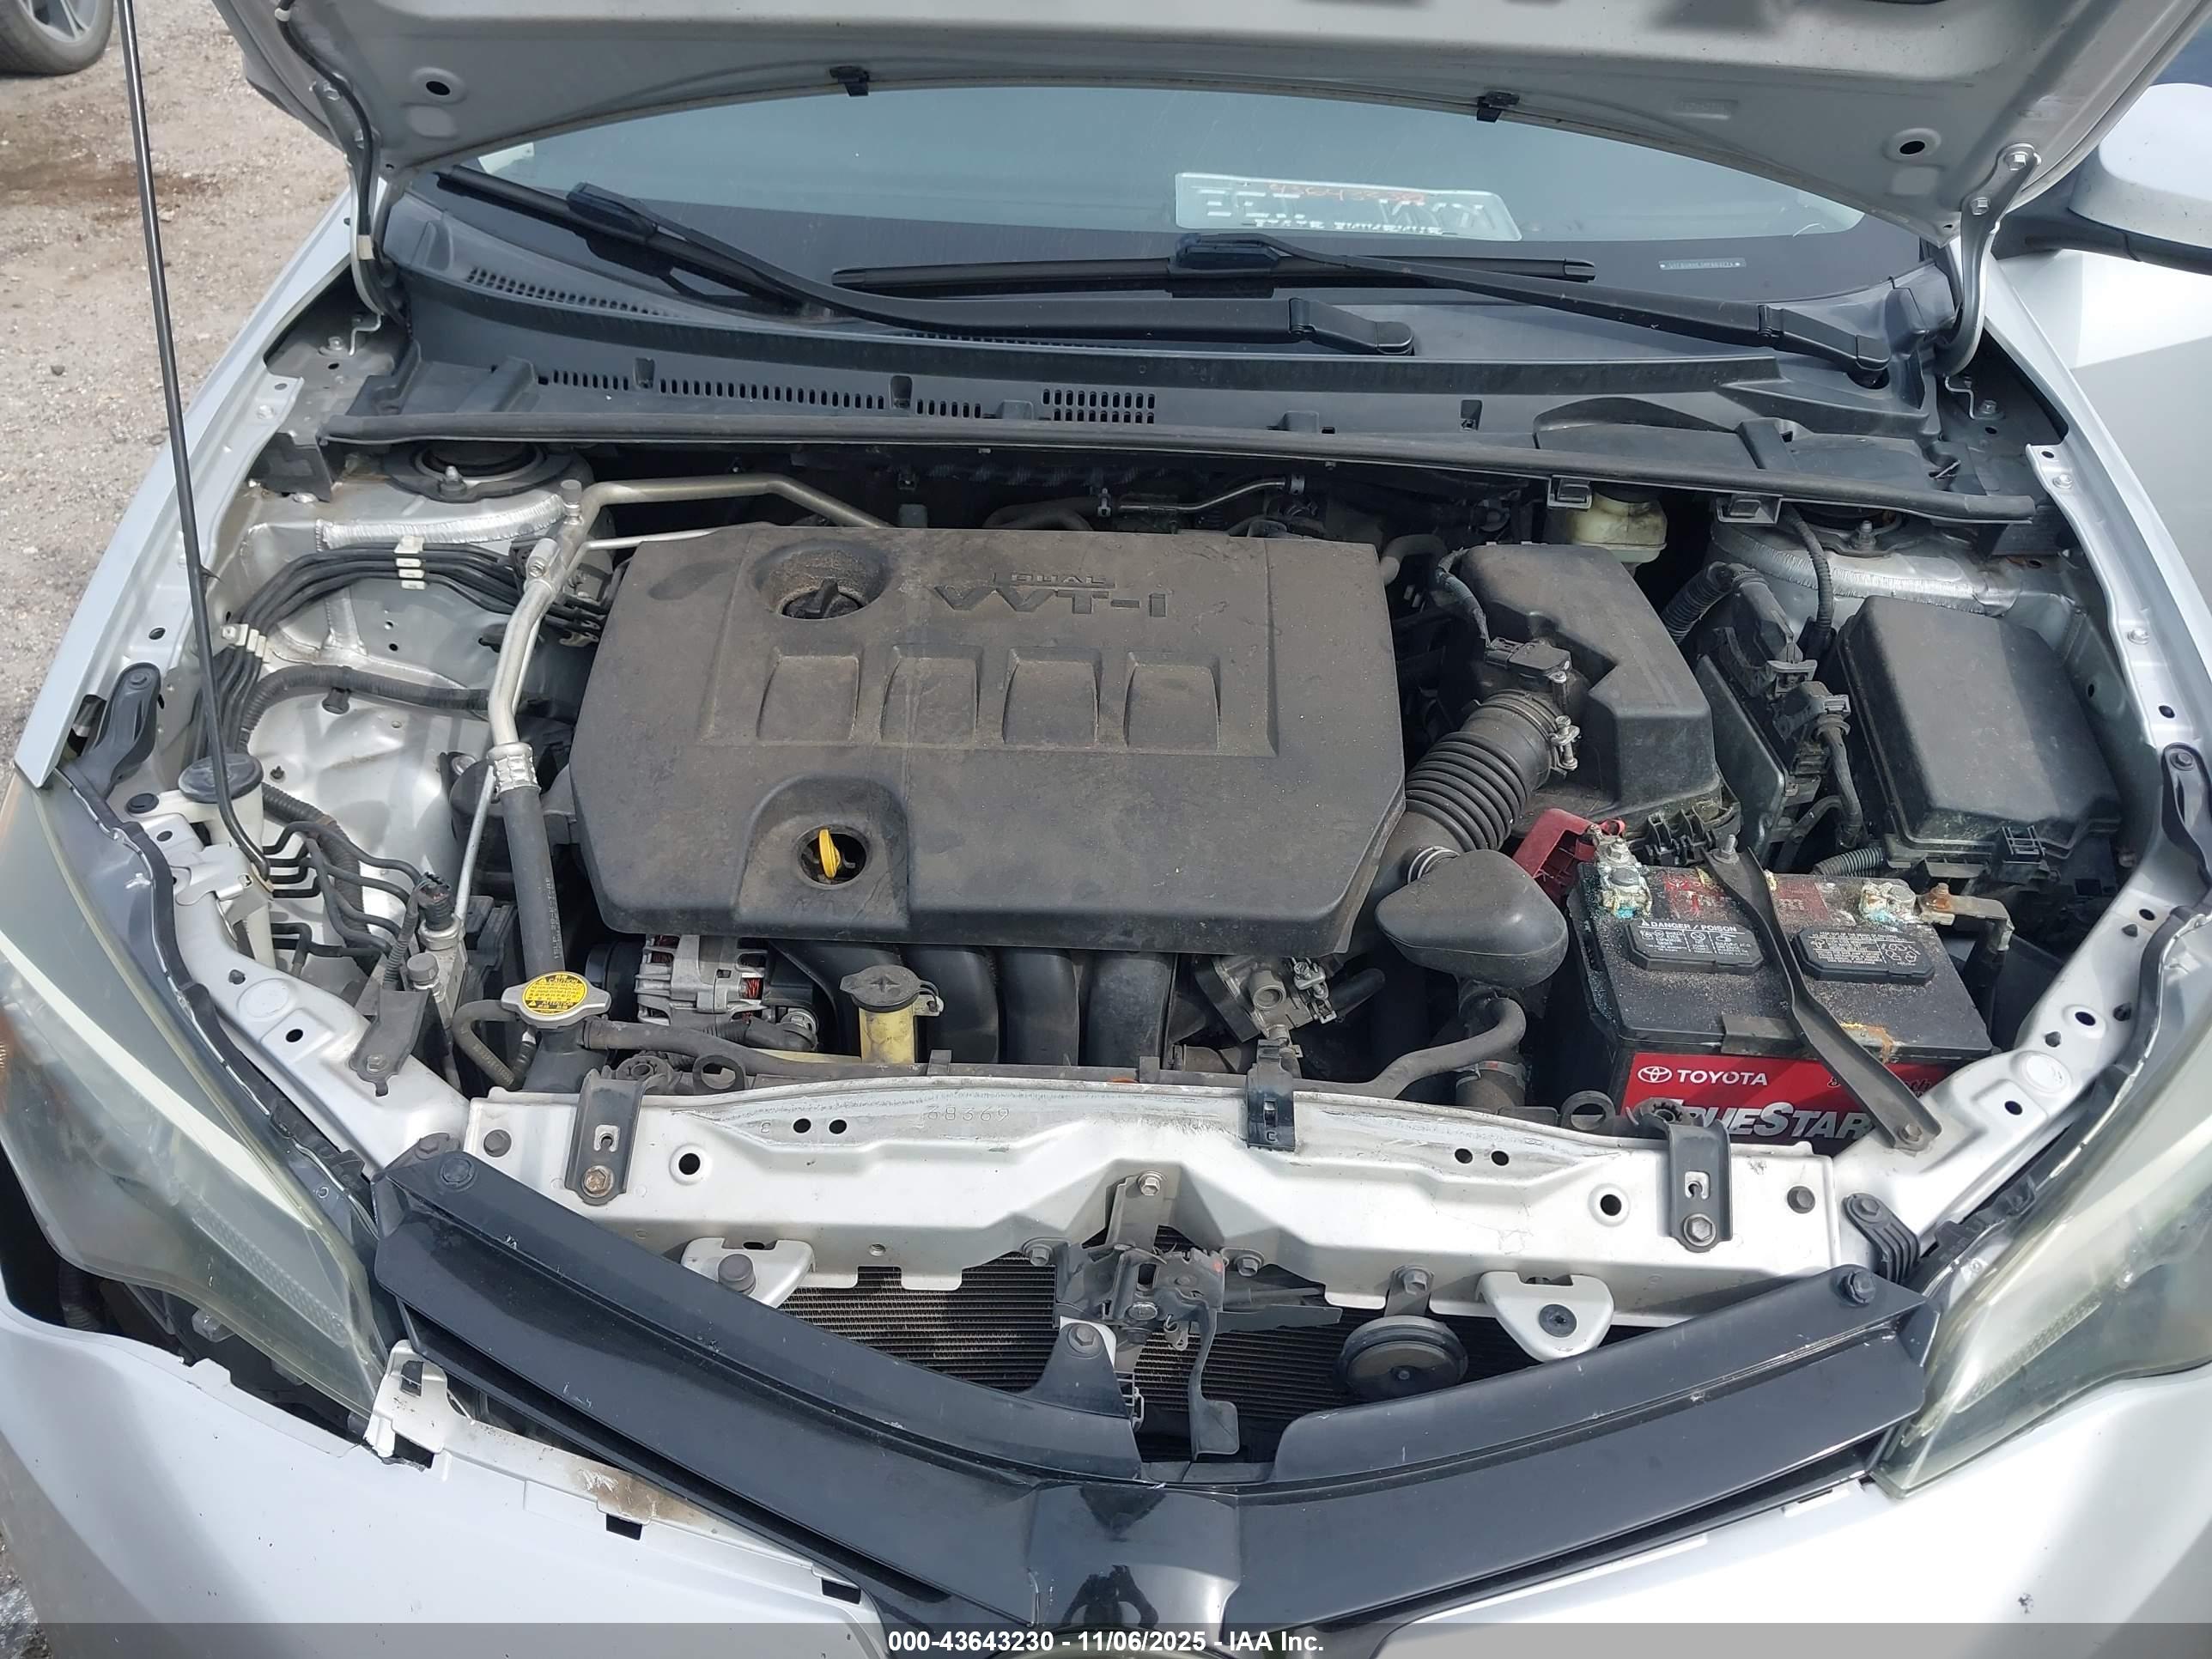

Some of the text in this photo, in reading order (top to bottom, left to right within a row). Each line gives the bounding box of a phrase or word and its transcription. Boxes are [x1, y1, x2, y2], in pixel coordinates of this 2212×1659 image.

[1011, 573, 1107, 585] DUAL
[1650, 921, 1691, 930] DANGER
[1701, 924, 1738, 933] POISON
[1677, 1069, 1768, 1087] TOYOTA
